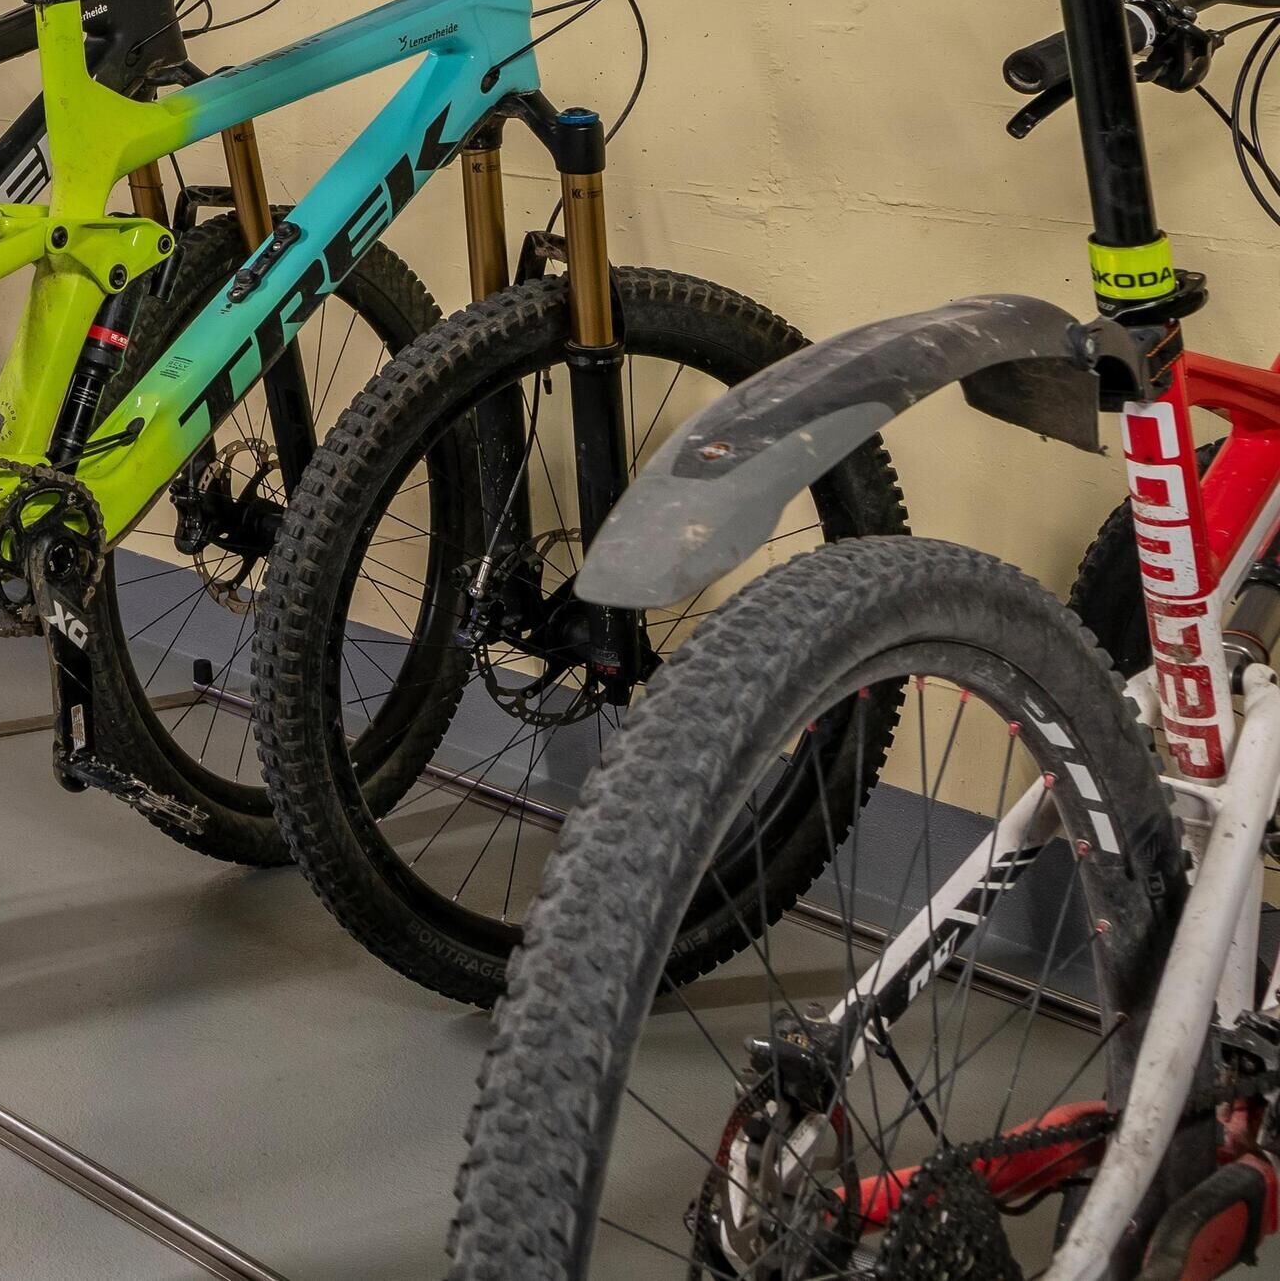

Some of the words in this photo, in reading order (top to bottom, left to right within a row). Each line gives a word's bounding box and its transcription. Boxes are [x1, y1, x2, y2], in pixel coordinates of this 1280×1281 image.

[81, 4, 108, 22] rheide
[409, 23, 459, 48] Lenzerheide
[178, 101, 459, 426] TREK
